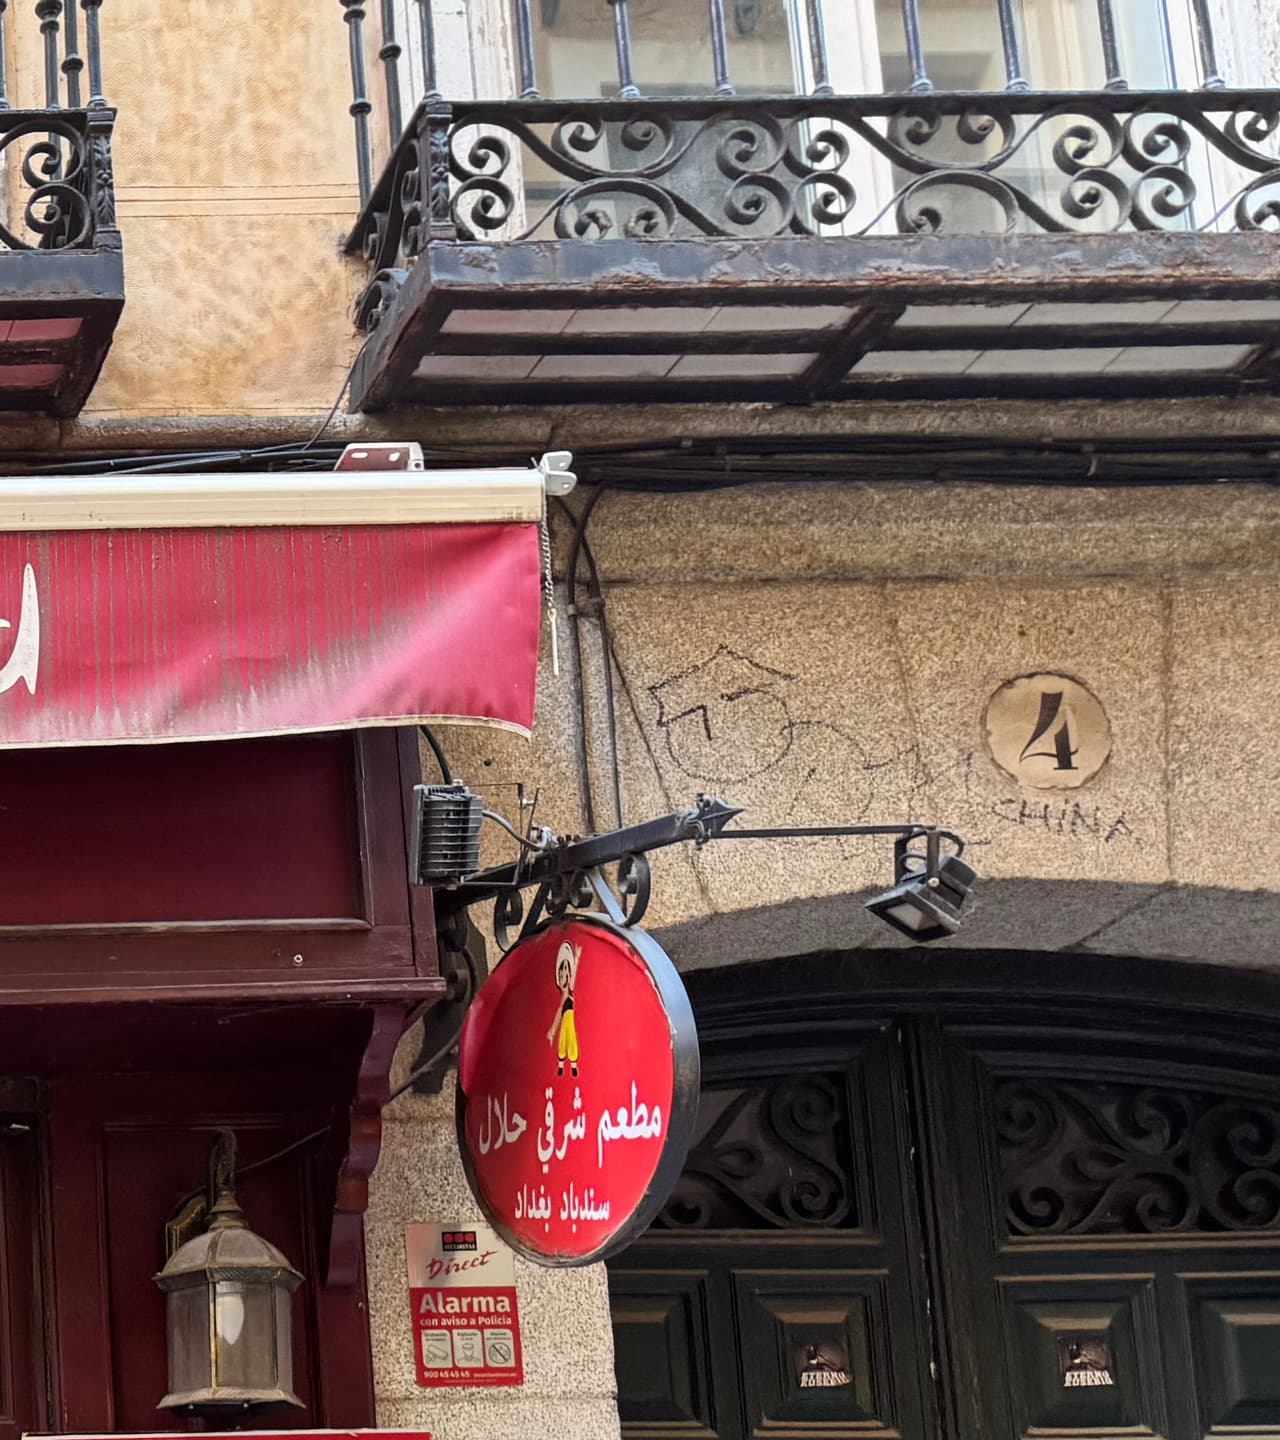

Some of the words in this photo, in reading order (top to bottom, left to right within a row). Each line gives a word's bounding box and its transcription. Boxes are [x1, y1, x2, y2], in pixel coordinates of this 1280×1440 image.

[1019, 691, 1079, 771] 4
[478, 1092, 527, 1155] حلال
[538, 1086, 586, 1174] شرقي
[598, 1079, 662, 1168] مطعم
[514, 1183, 552, 1232] بغداد
[559, 1182, 610, 1233] سندباد
[426, 1250, 497, 1280] Direct
[419, 1291, 511, 1314] Alarma
[420, 1317, 438, 1326] con
[441, 1316, 467, 1326] aviso
[469, 1317, 477, 1326] a
